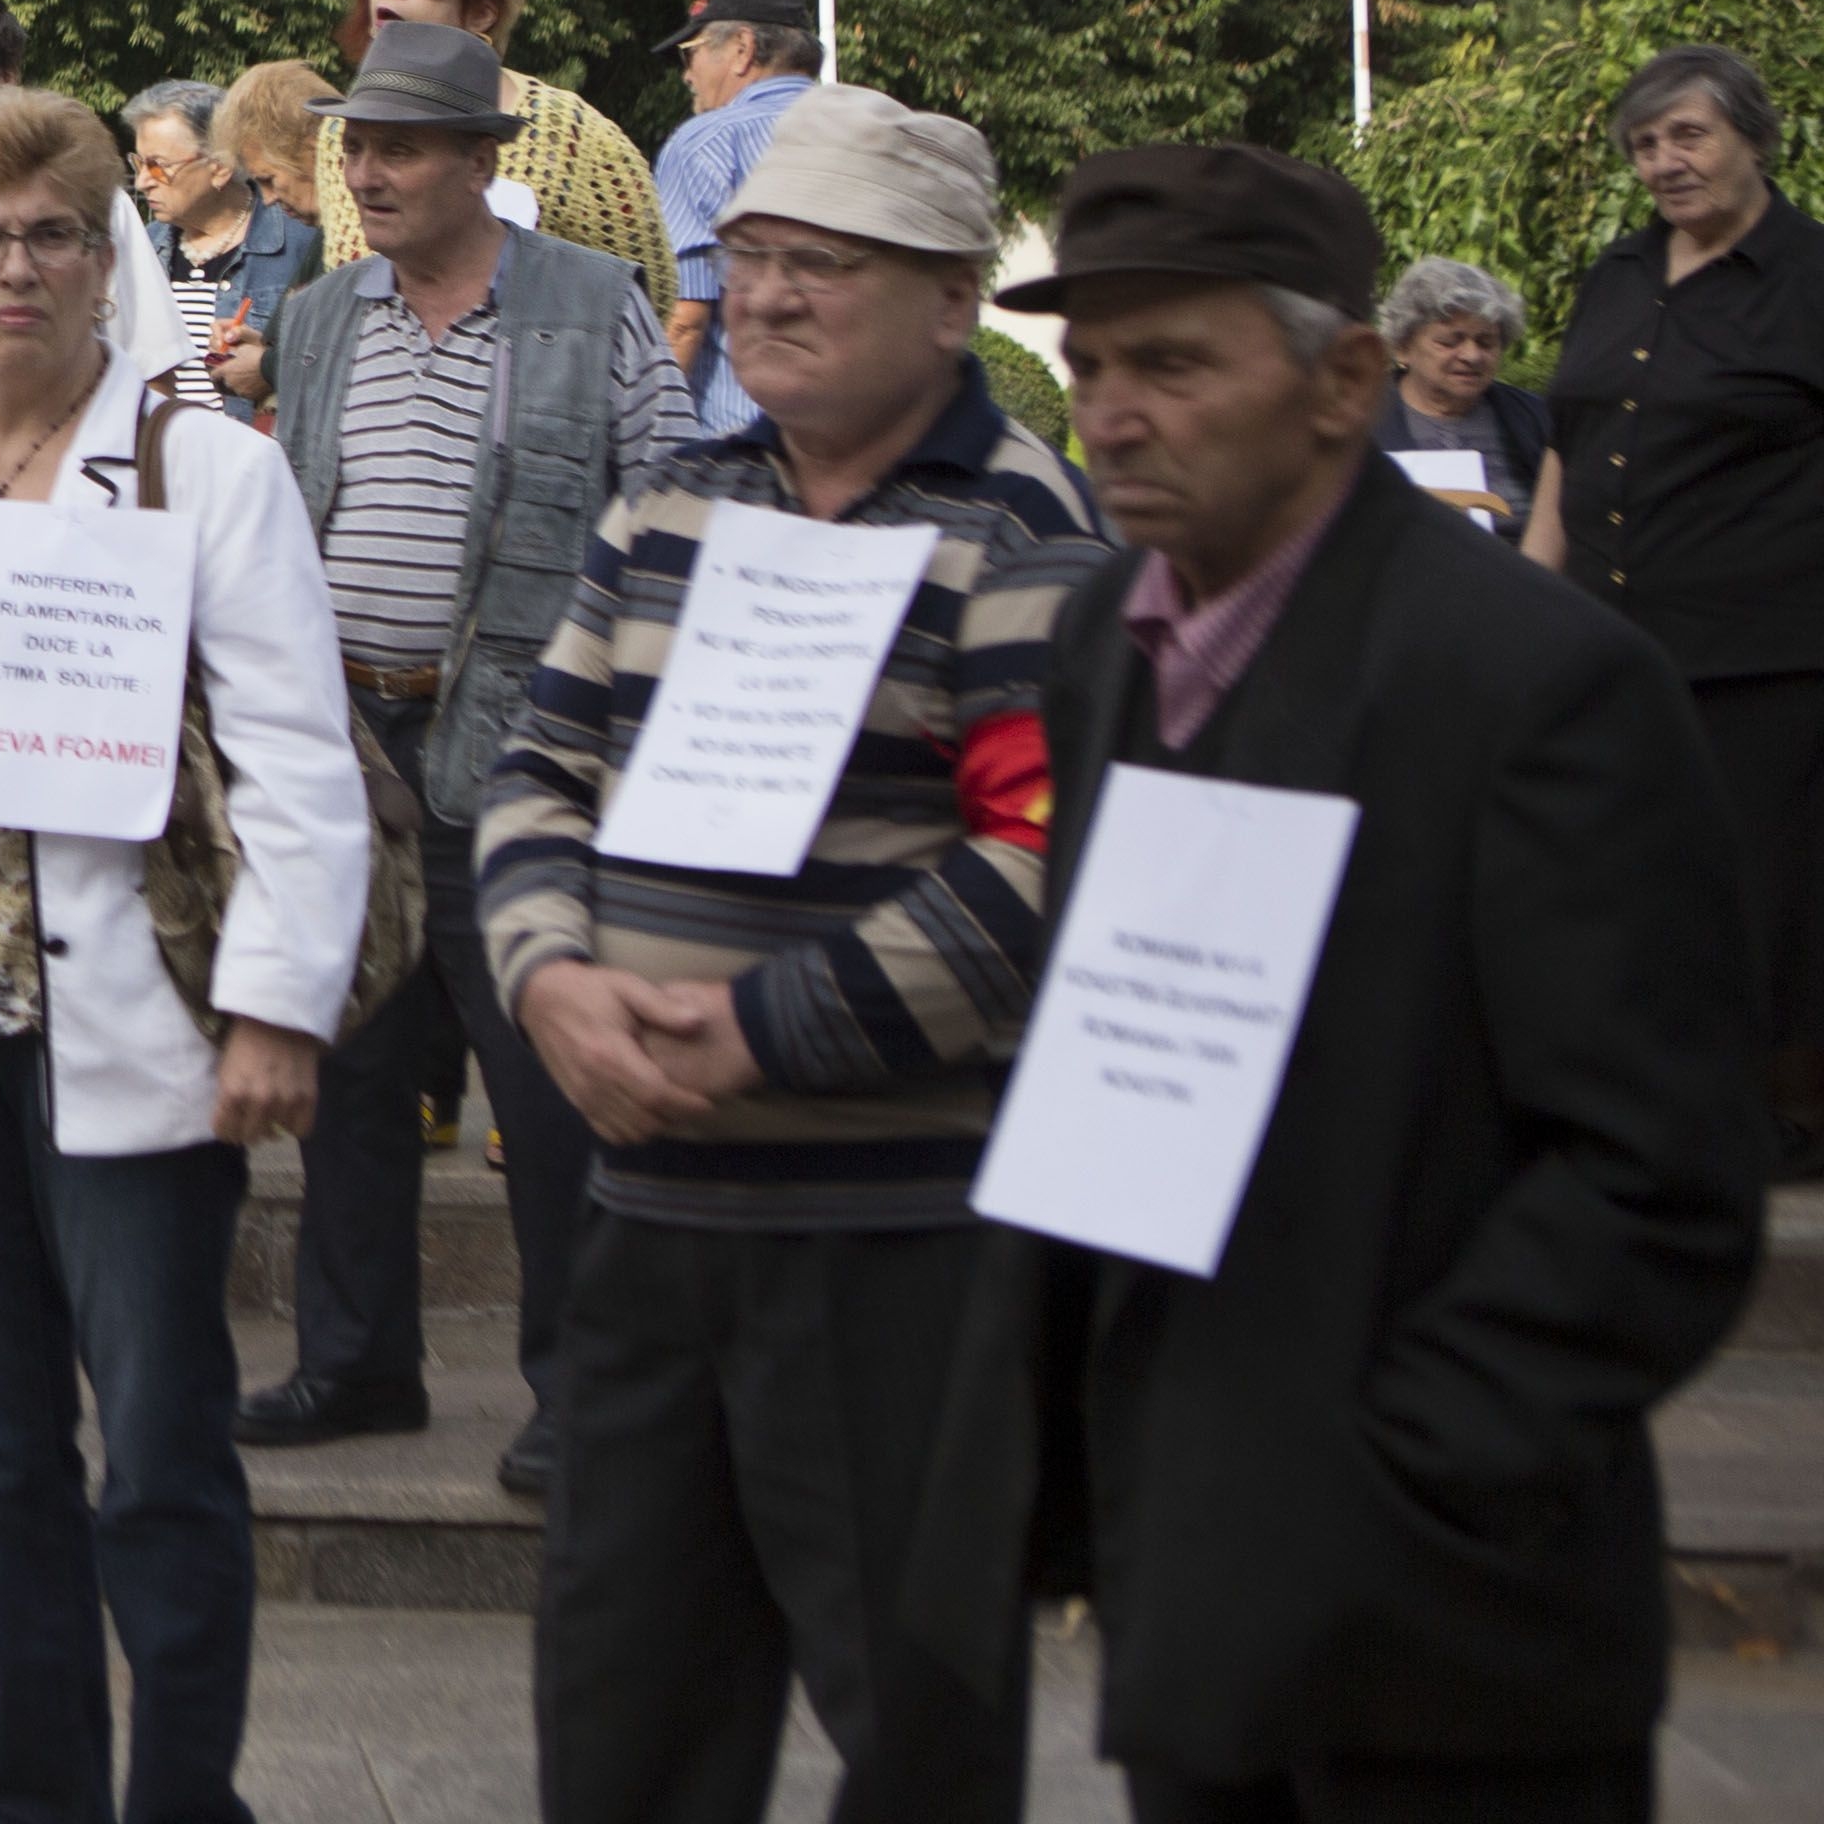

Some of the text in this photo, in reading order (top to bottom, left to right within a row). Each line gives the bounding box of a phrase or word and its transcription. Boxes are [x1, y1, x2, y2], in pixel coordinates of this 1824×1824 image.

[10, 571, 137, 601] INDIFERENTA
[23, 633, 115, 660] DUCE LA
[56, 734, 167, 770] FOAMEI
